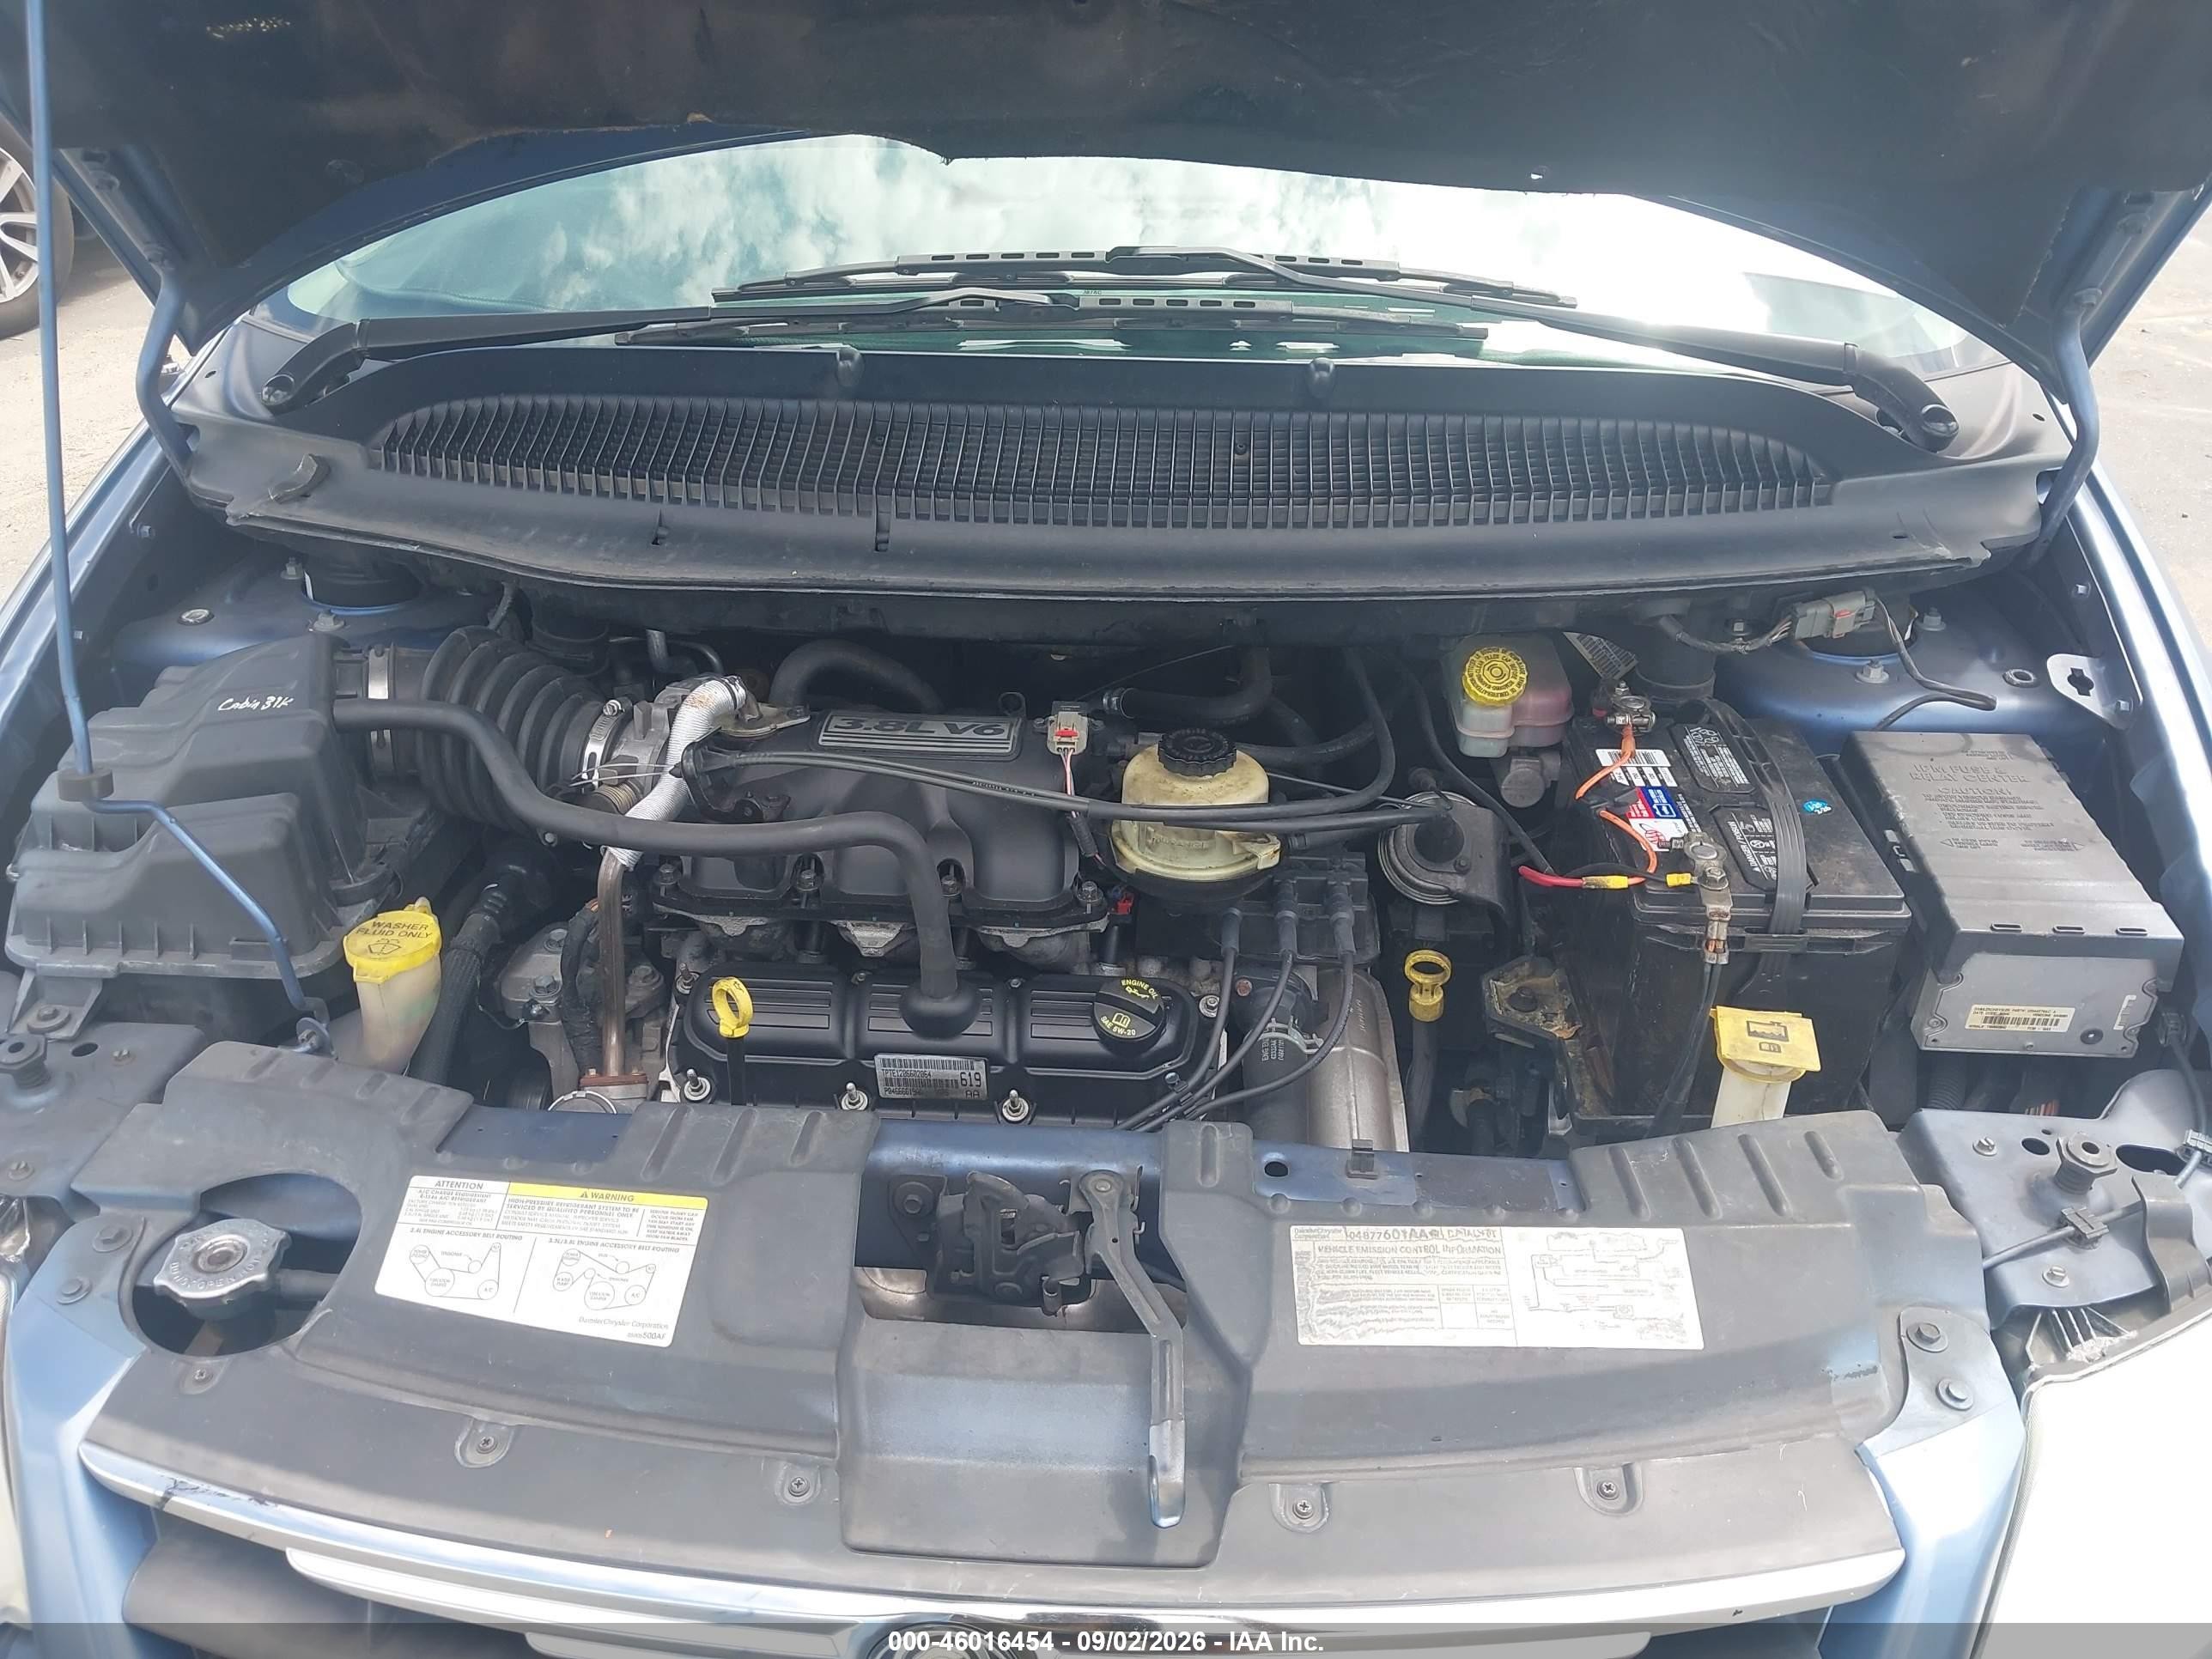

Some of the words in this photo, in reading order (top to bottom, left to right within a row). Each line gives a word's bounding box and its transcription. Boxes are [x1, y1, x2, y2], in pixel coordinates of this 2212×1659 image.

[834, 718, 935, 733] 3.8L
[945, 722, 1005, 736] V6
[1963, 775, 2031, 783] CENTER
[373, 921, 429, 930] WASHER
[356, 927, 395, 936] FLUID
[1121, 979, 1150, 990] ENGINE
[1148, 988, 1158, 1000] OIL
[1100, 1016, 1114, 1030] SAE
[1113, 1026, 1136, 1036] 5W-20
[960, 1072, 981, 1087] 619
[434, 1181, 483, 1189] ATTENTION
[591, 1192, 635, 1202] WARNING
[599, 1242, 636, 1250] ACCESSORY
[1318, 1245, 1354, 1254] VEHICLE
[1355, 1245, 1398, 1254] EMISSION
[1400, 1244, 1440, 1255] CONTROL
[1443, 1244, 1502, 1255] INFORMATION
[631, 1319, 669, 1330] Corporation
